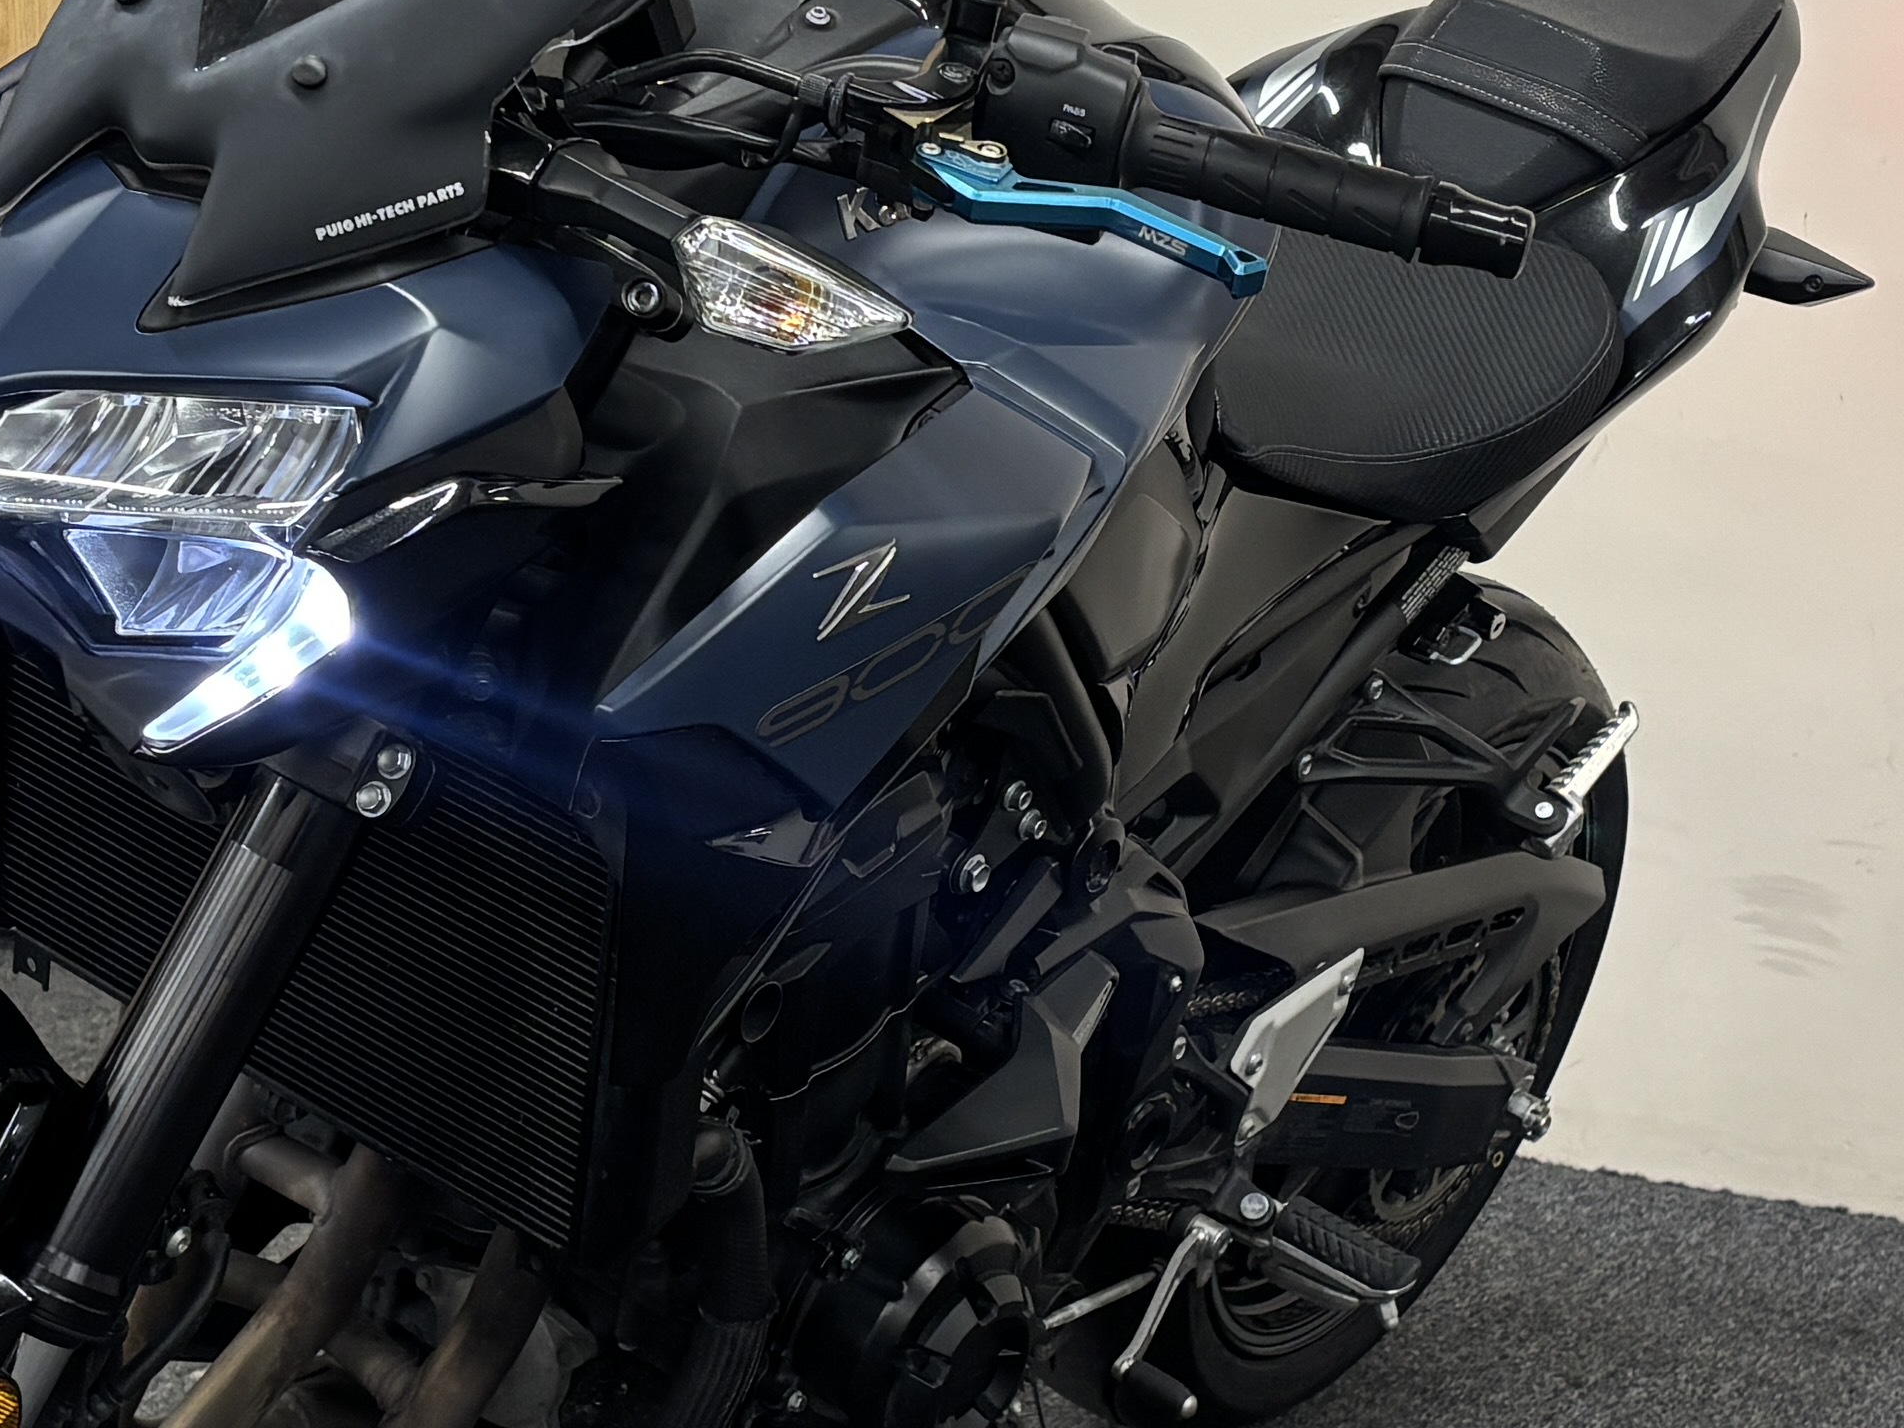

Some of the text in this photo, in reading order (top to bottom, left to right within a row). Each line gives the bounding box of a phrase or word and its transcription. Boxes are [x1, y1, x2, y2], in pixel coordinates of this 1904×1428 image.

[354, 198, 416, 228] HI-TECH
[416, 181, 465, 209] PARTS
[1138, 225, 1189, 256] MZS
